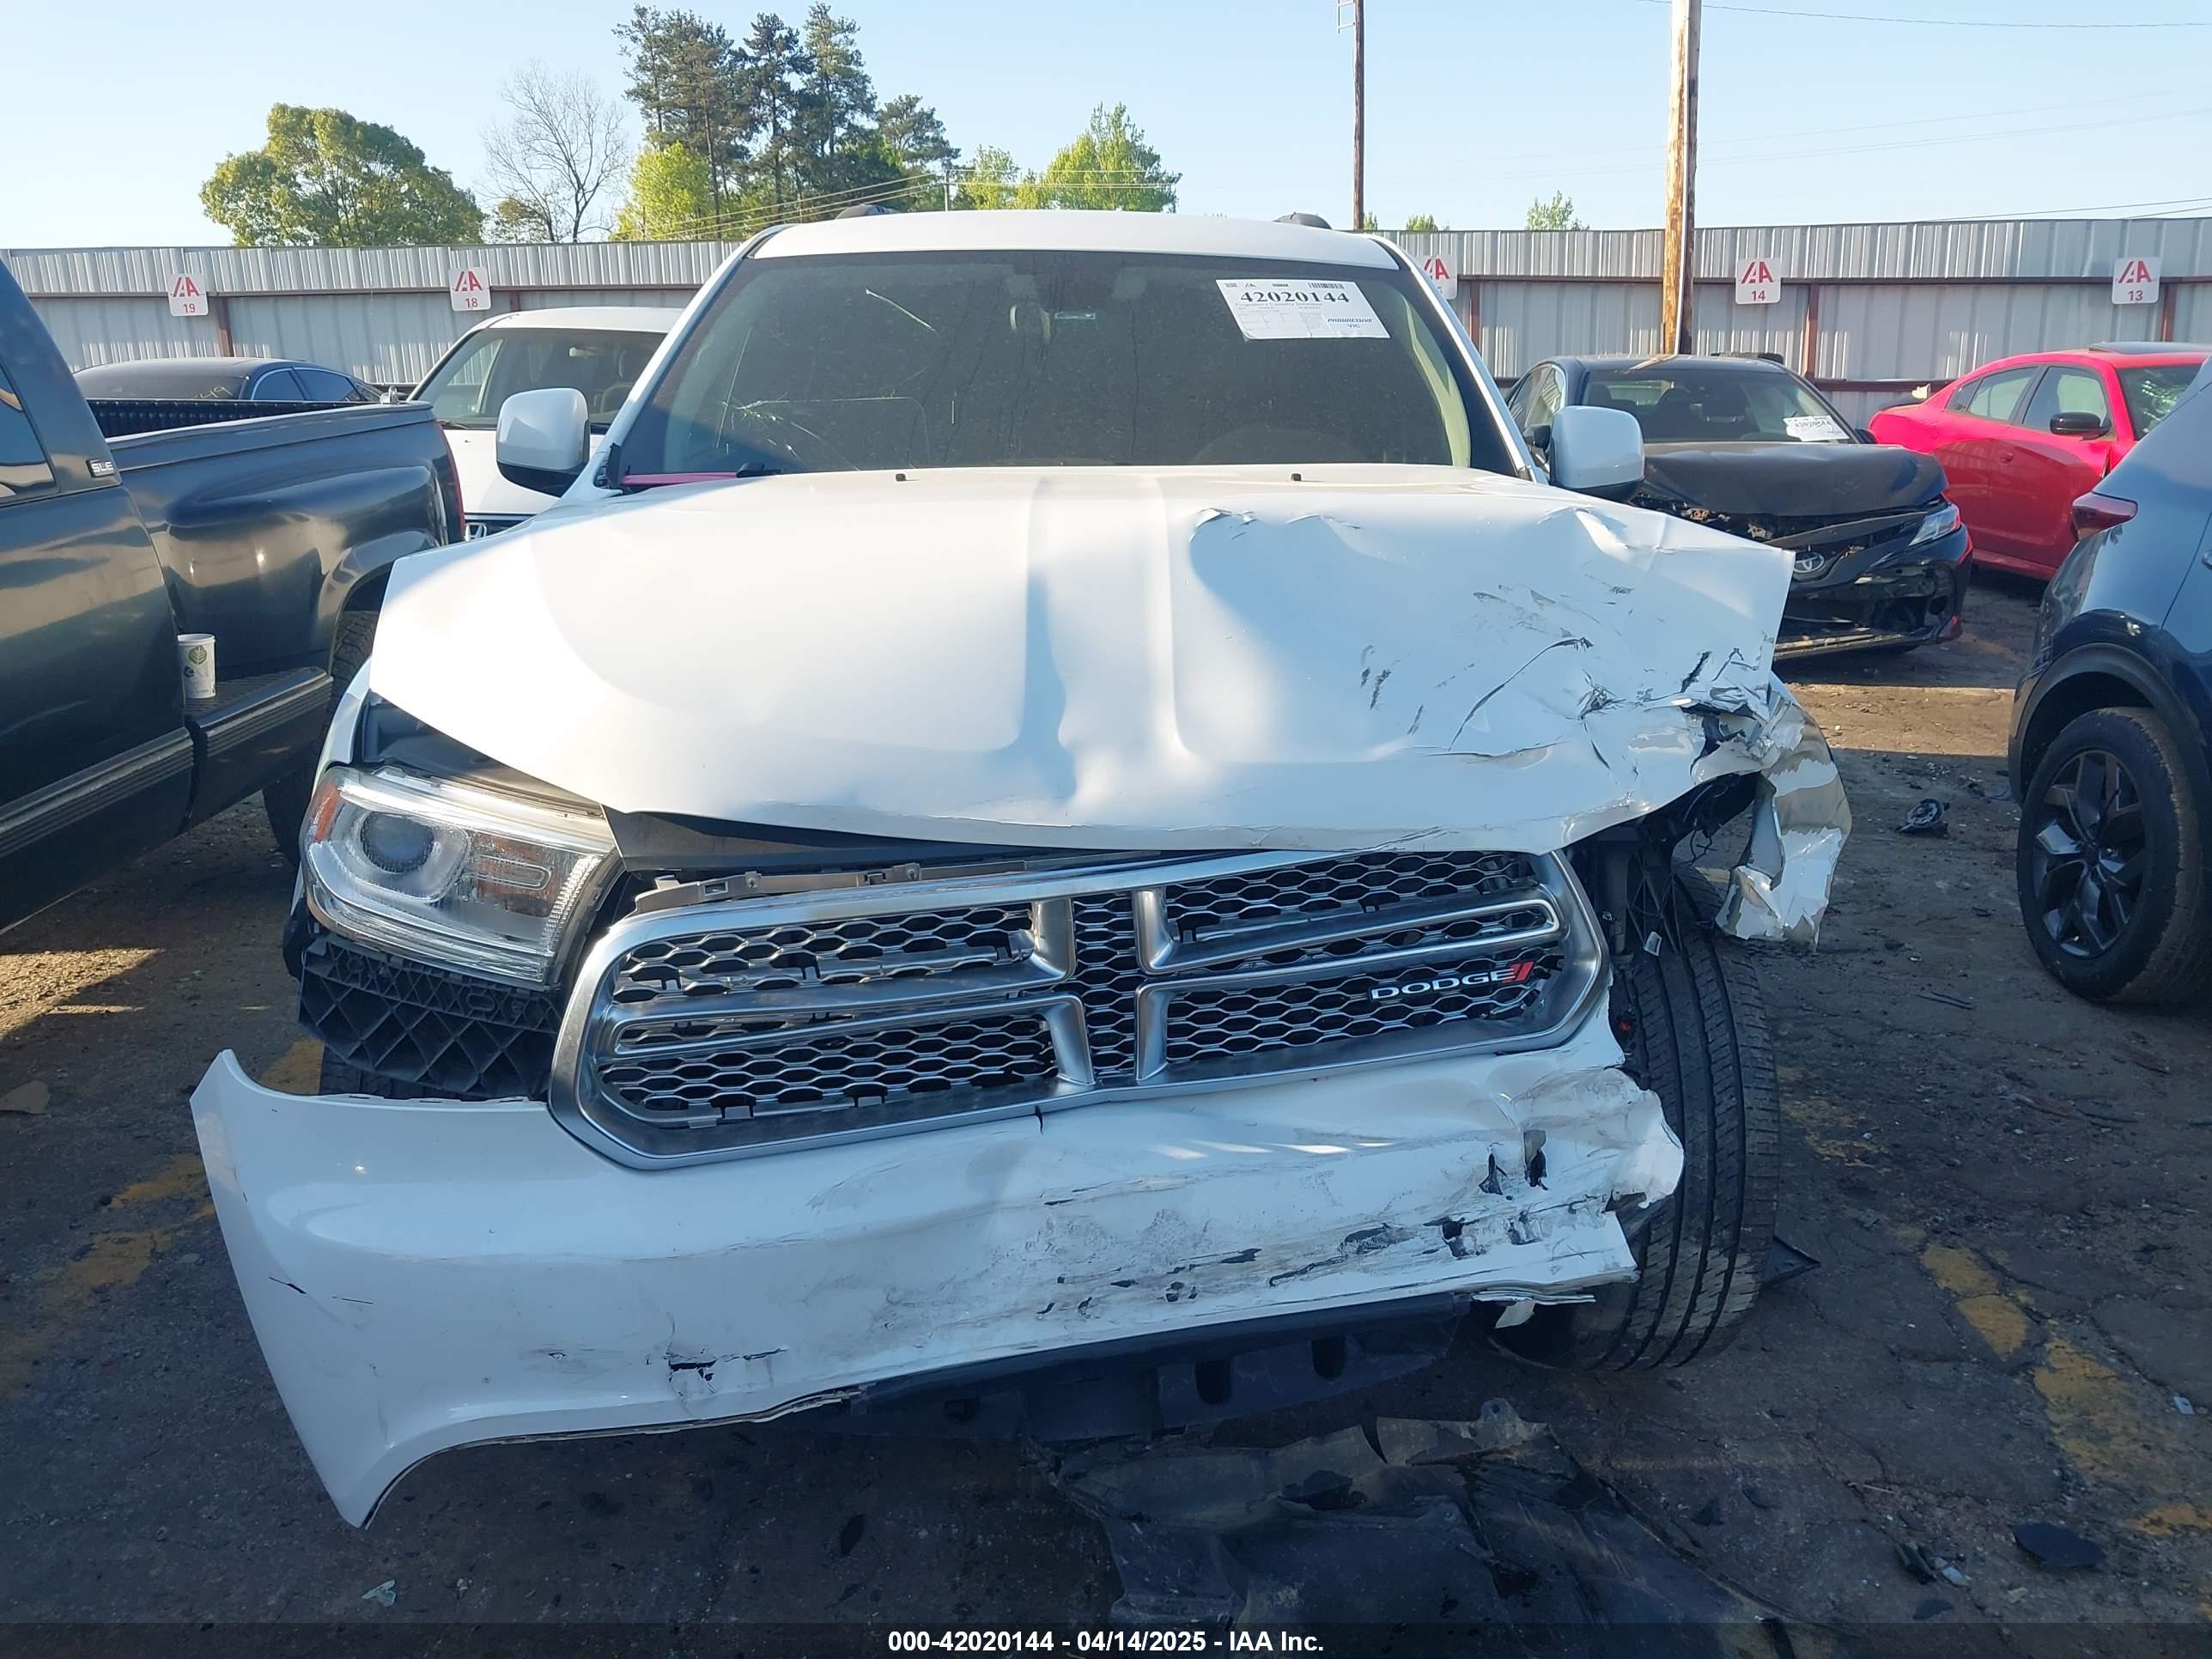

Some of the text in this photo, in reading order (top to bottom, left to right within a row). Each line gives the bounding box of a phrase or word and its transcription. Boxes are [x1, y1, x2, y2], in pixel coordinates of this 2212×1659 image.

[1240, 291, 1350, 302] 42020144
[1751, 289, 1765, 301] 14
[2128, 289, 2143, 301] 13
[183, 302, 196, 313] 19
[465, 297, 478, 308] 18
[91, 461, 113, 472] SLE
[1370, 968, 1516, 1000] DODGE
